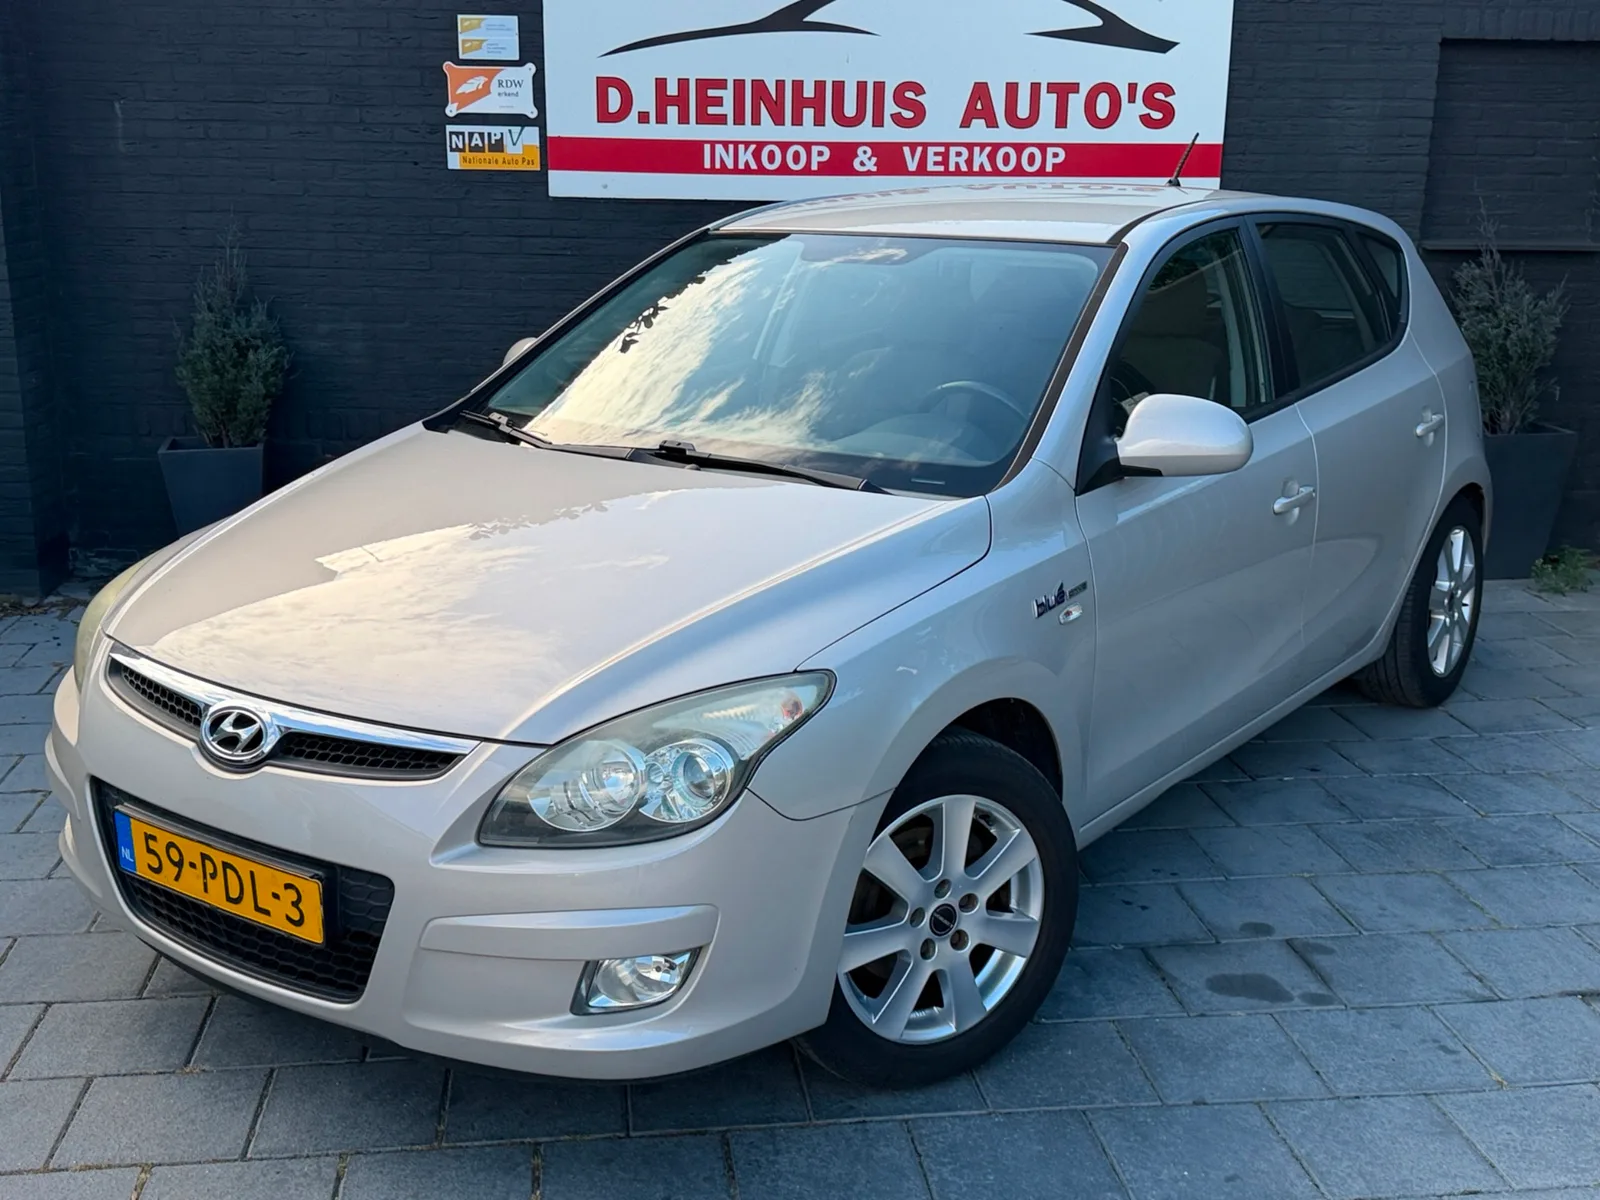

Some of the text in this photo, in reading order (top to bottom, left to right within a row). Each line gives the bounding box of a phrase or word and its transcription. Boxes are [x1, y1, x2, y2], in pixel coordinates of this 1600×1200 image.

[497, 79, 524, 88] RDW
[596, 76, 1176, 130] D.HEINHUIS AUTO'S
[462, 156, 499, 164] Nationale
[501, 157, 519, 165] Auto
[703, 143, 1066, 173] INKOOP & VERKOOP
[121, 846, 134, 862] NL
[143, 831, 305, 928] 59-PDL-3
